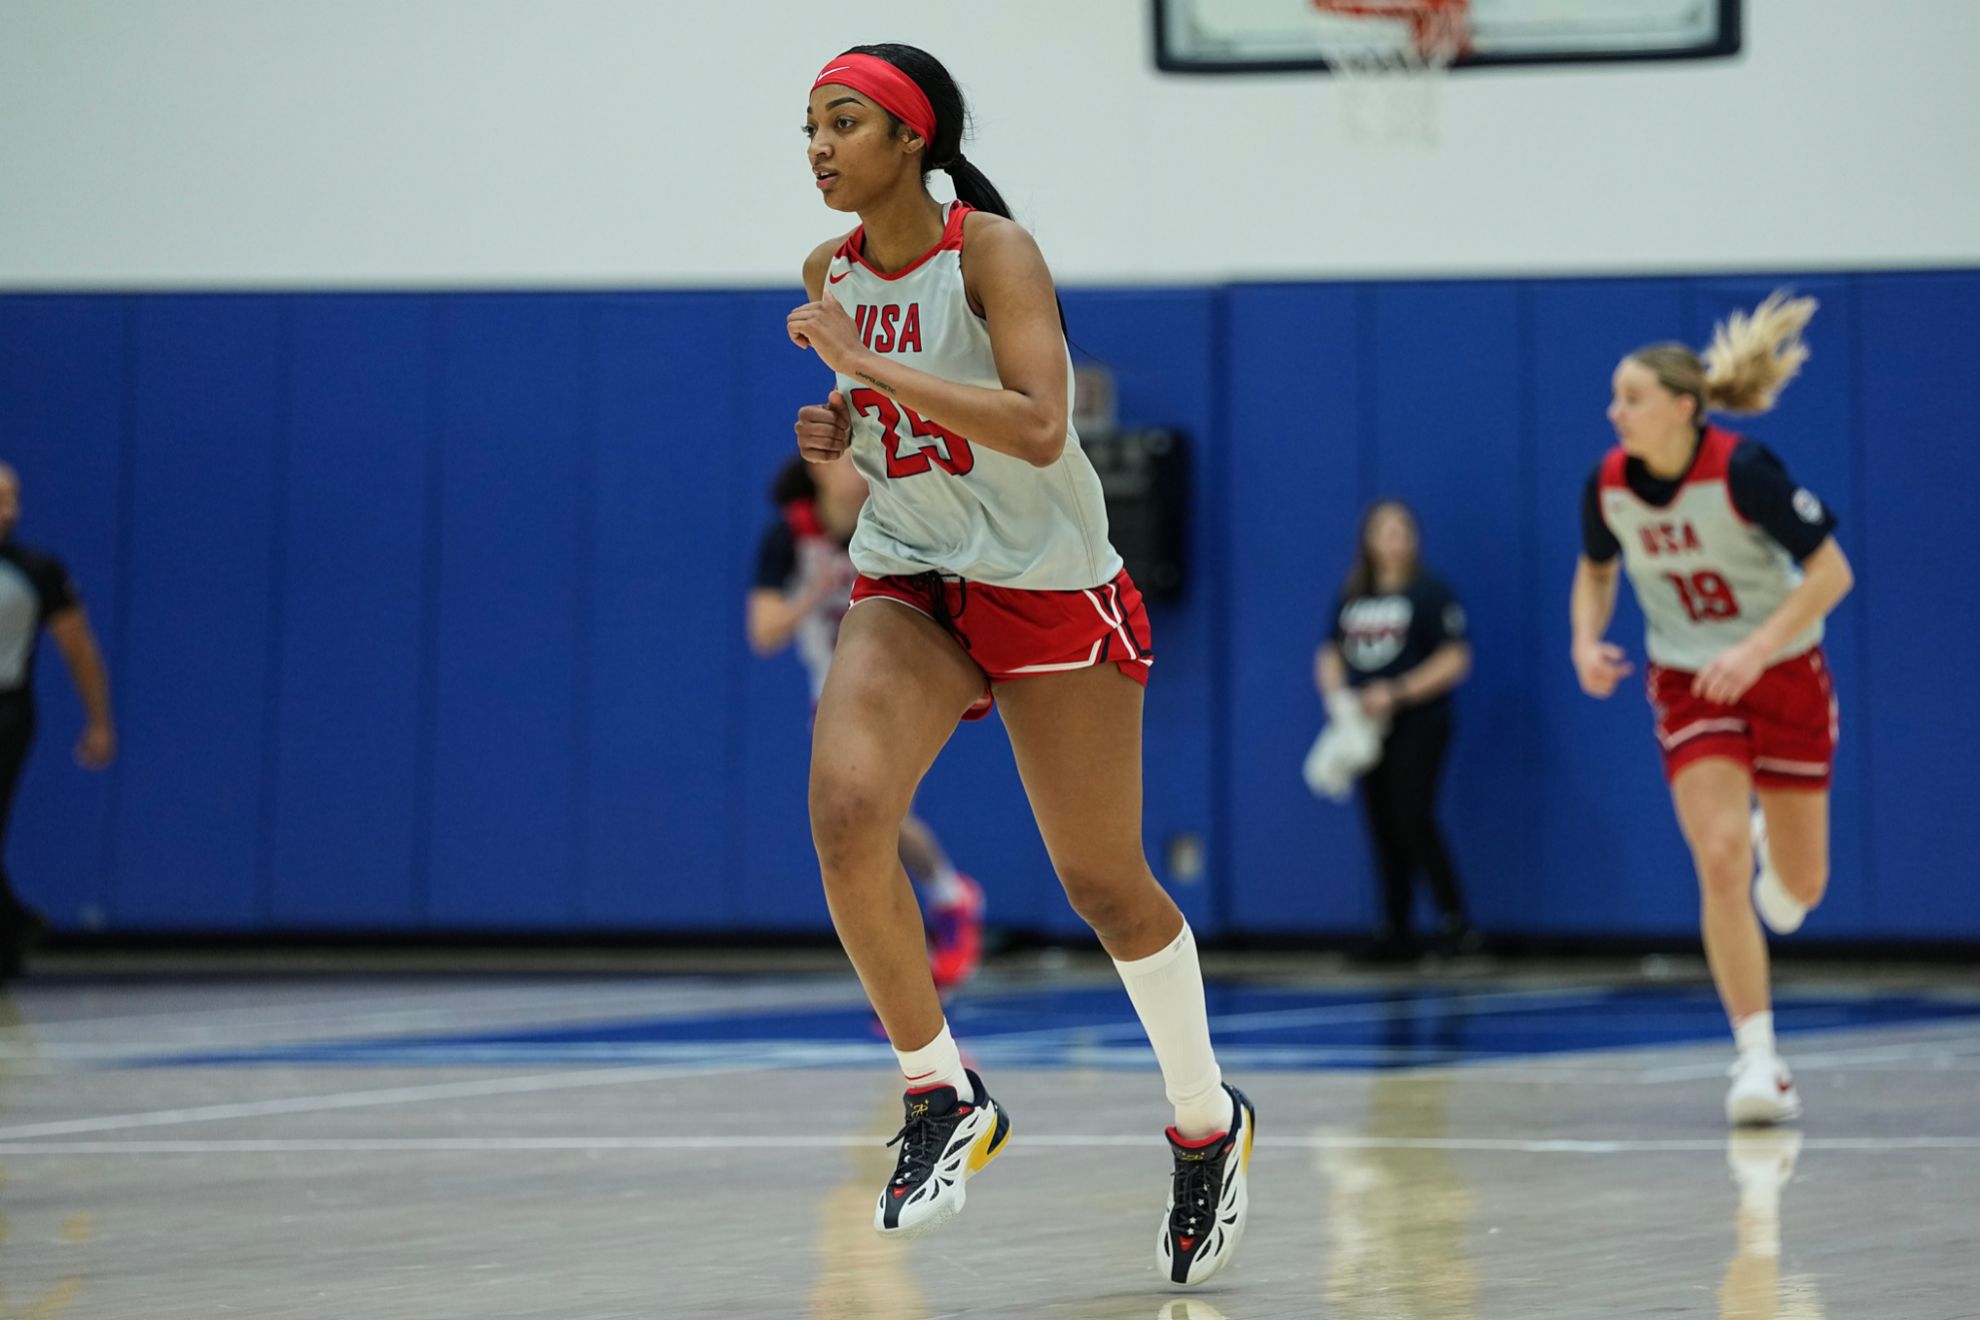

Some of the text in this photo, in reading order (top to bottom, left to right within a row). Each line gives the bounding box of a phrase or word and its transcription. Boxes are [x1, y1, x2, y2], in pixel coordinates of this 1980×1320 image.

[855, 303, 922, 353] USA
[850, 388, 975, 479] 25
[1638, 521, 1702, 557] USA
[1663, 569, 1741, 623] 19
